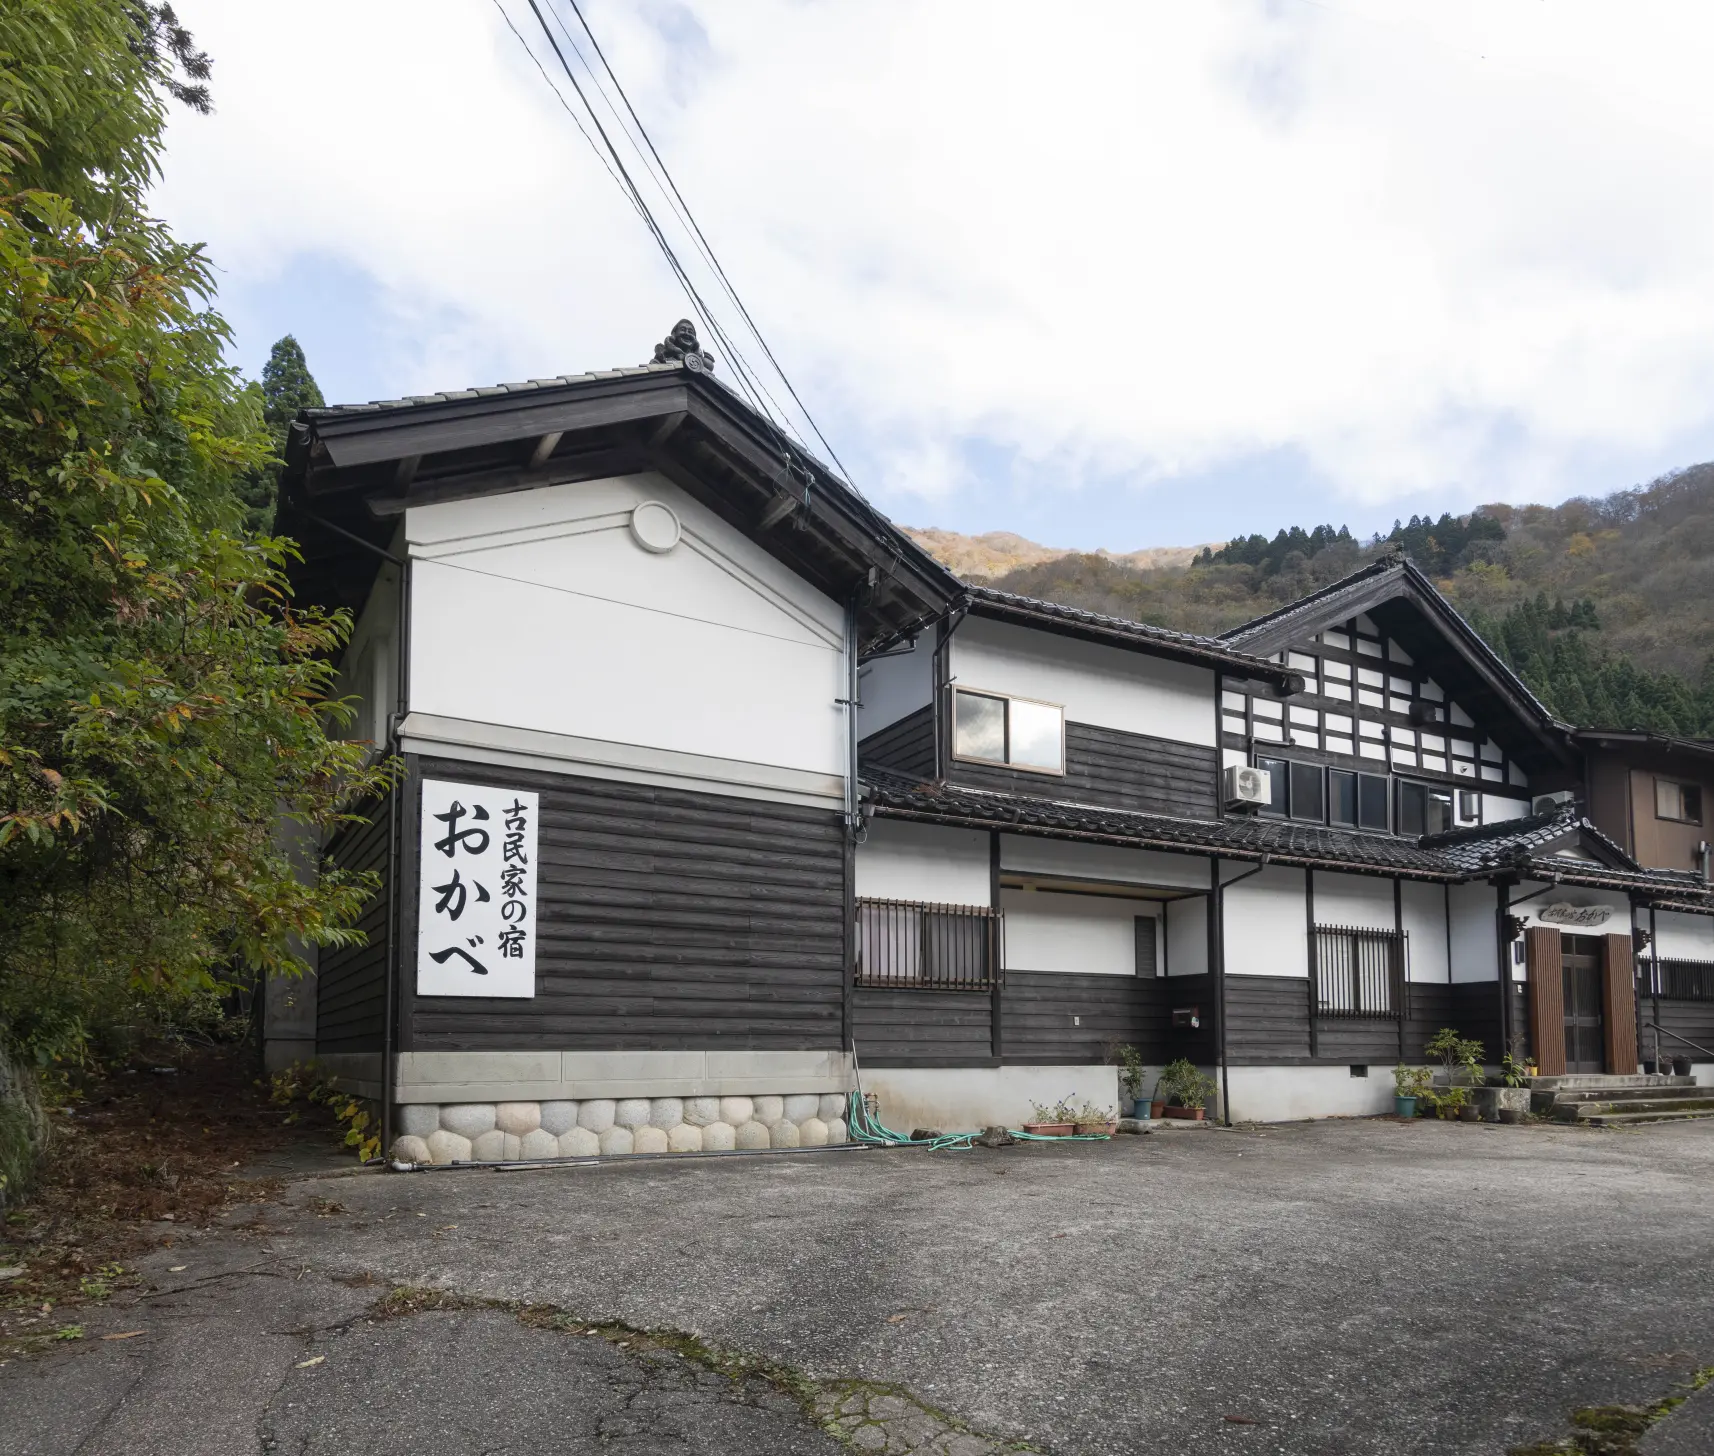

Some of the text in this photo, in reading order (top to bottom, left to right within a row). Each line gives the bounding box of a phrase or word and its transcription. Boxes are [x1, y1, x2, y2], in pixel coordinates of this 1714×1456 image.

[429, 800, 491, 976] おかべ
[498, 798, 529, 959] 古民家の宿
